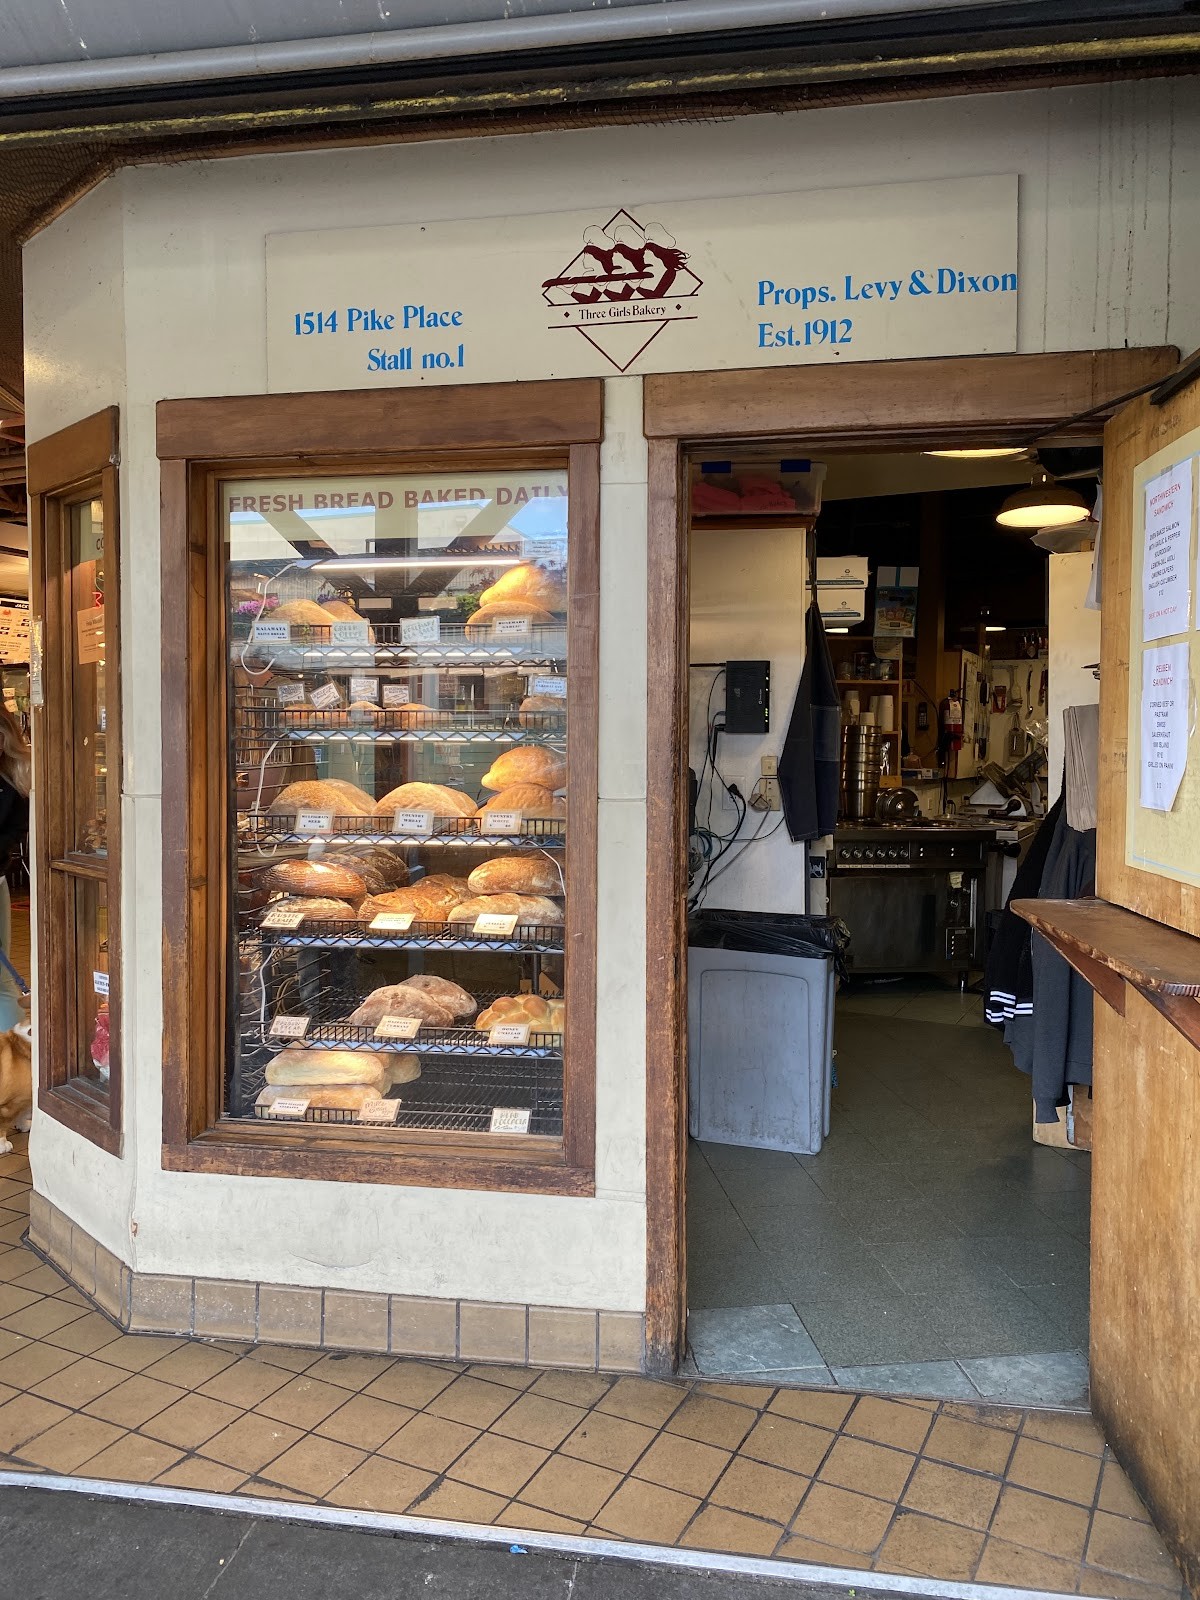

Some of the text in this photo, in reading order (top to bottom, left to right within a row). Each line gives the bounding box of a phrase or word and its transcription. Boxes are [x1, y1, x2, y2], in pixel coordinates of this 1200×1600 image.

[757, 267, 1018, 310] Props. Levy & Dixon
[293, 303, 463, 336] 1514 Pike Place
[578, 303, 667, 321] Three Girls Bakery
[366, 343, 465, 372] Stall no.1
[229, 493, 304, 513] FRESH
[313, 491, 395, 510] BREAD
[404, 488, 486, 509] BAKED
[1153, 501, 1174, 517] SANDWICH
[1152, 676, 1174, 687] SANDWICH
